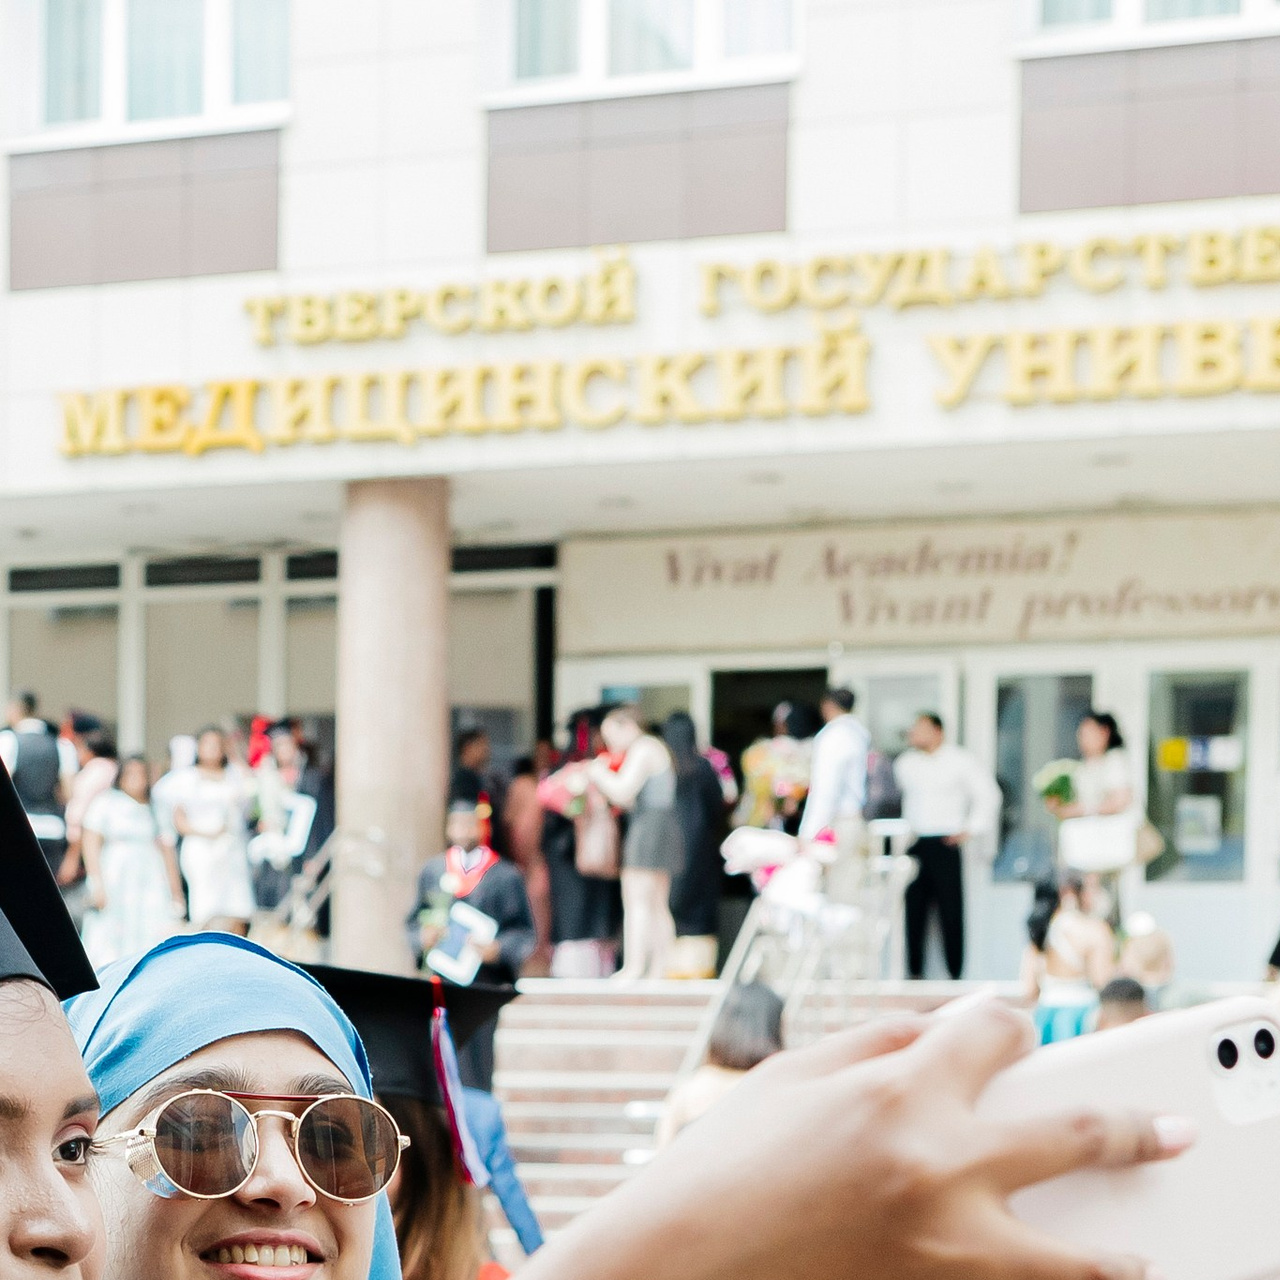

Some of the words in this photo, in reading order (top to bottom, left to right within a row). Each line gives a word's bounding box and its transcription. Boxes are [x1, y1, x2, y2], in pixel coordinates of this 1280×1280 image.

[245, 246, 635, 347] ТВЕРСКОЙ
[59, 318, 871, 457] МЕДИЦИНСКИЙ
[664, 545, 779, 588] Vivat
[806, 530, 1080, 580] Academia!
[836, 586, 994, 627] Vivant
